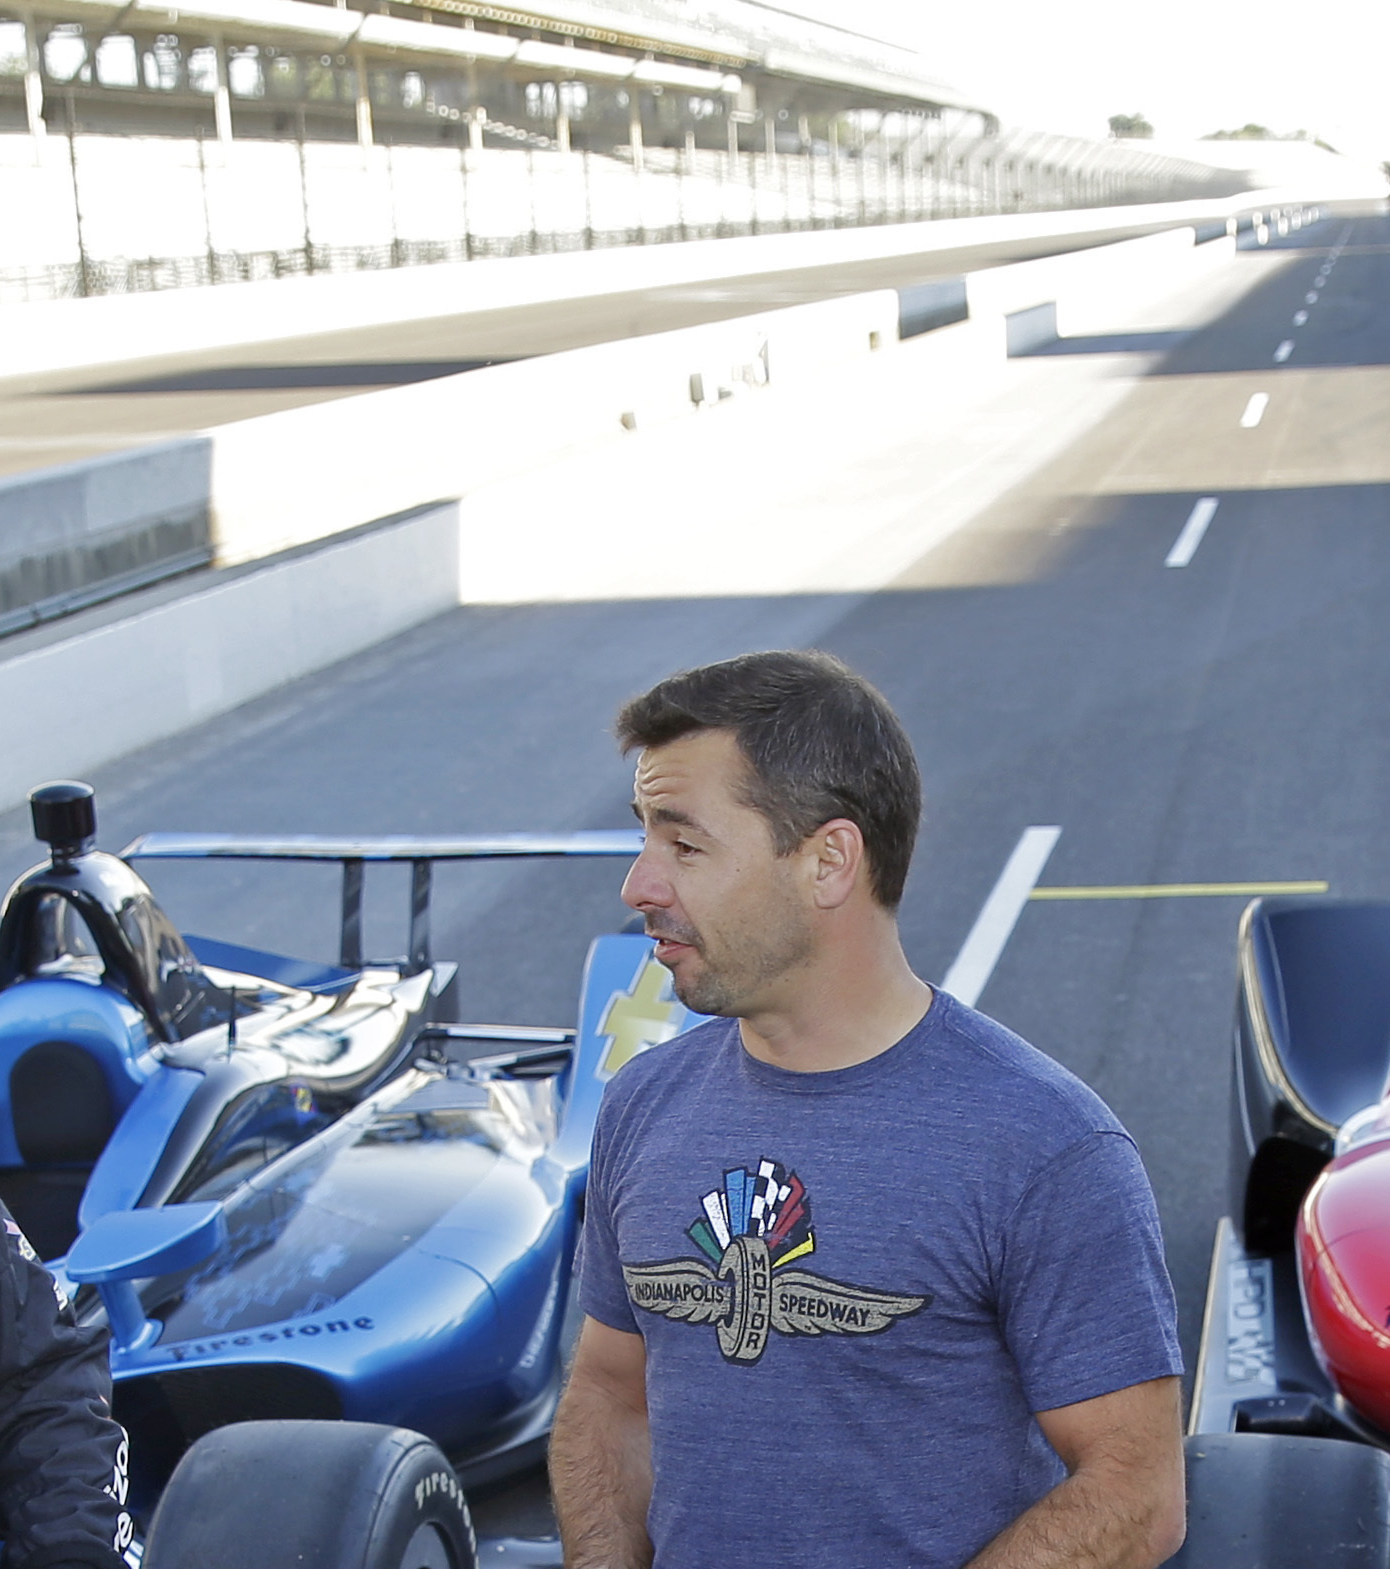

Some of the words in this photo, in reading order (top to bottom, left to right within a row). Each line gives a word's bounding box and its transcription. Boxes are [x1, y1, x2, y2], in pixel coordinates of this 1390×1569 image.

[634, 1281, 725, 1303] INDIANAPOLIS
[745, 1252, 767, 1349] MOTOR
[778, 1293, 871, 1327] SPEEDWAY
[166, 1313, 375, 1361] Firestone
